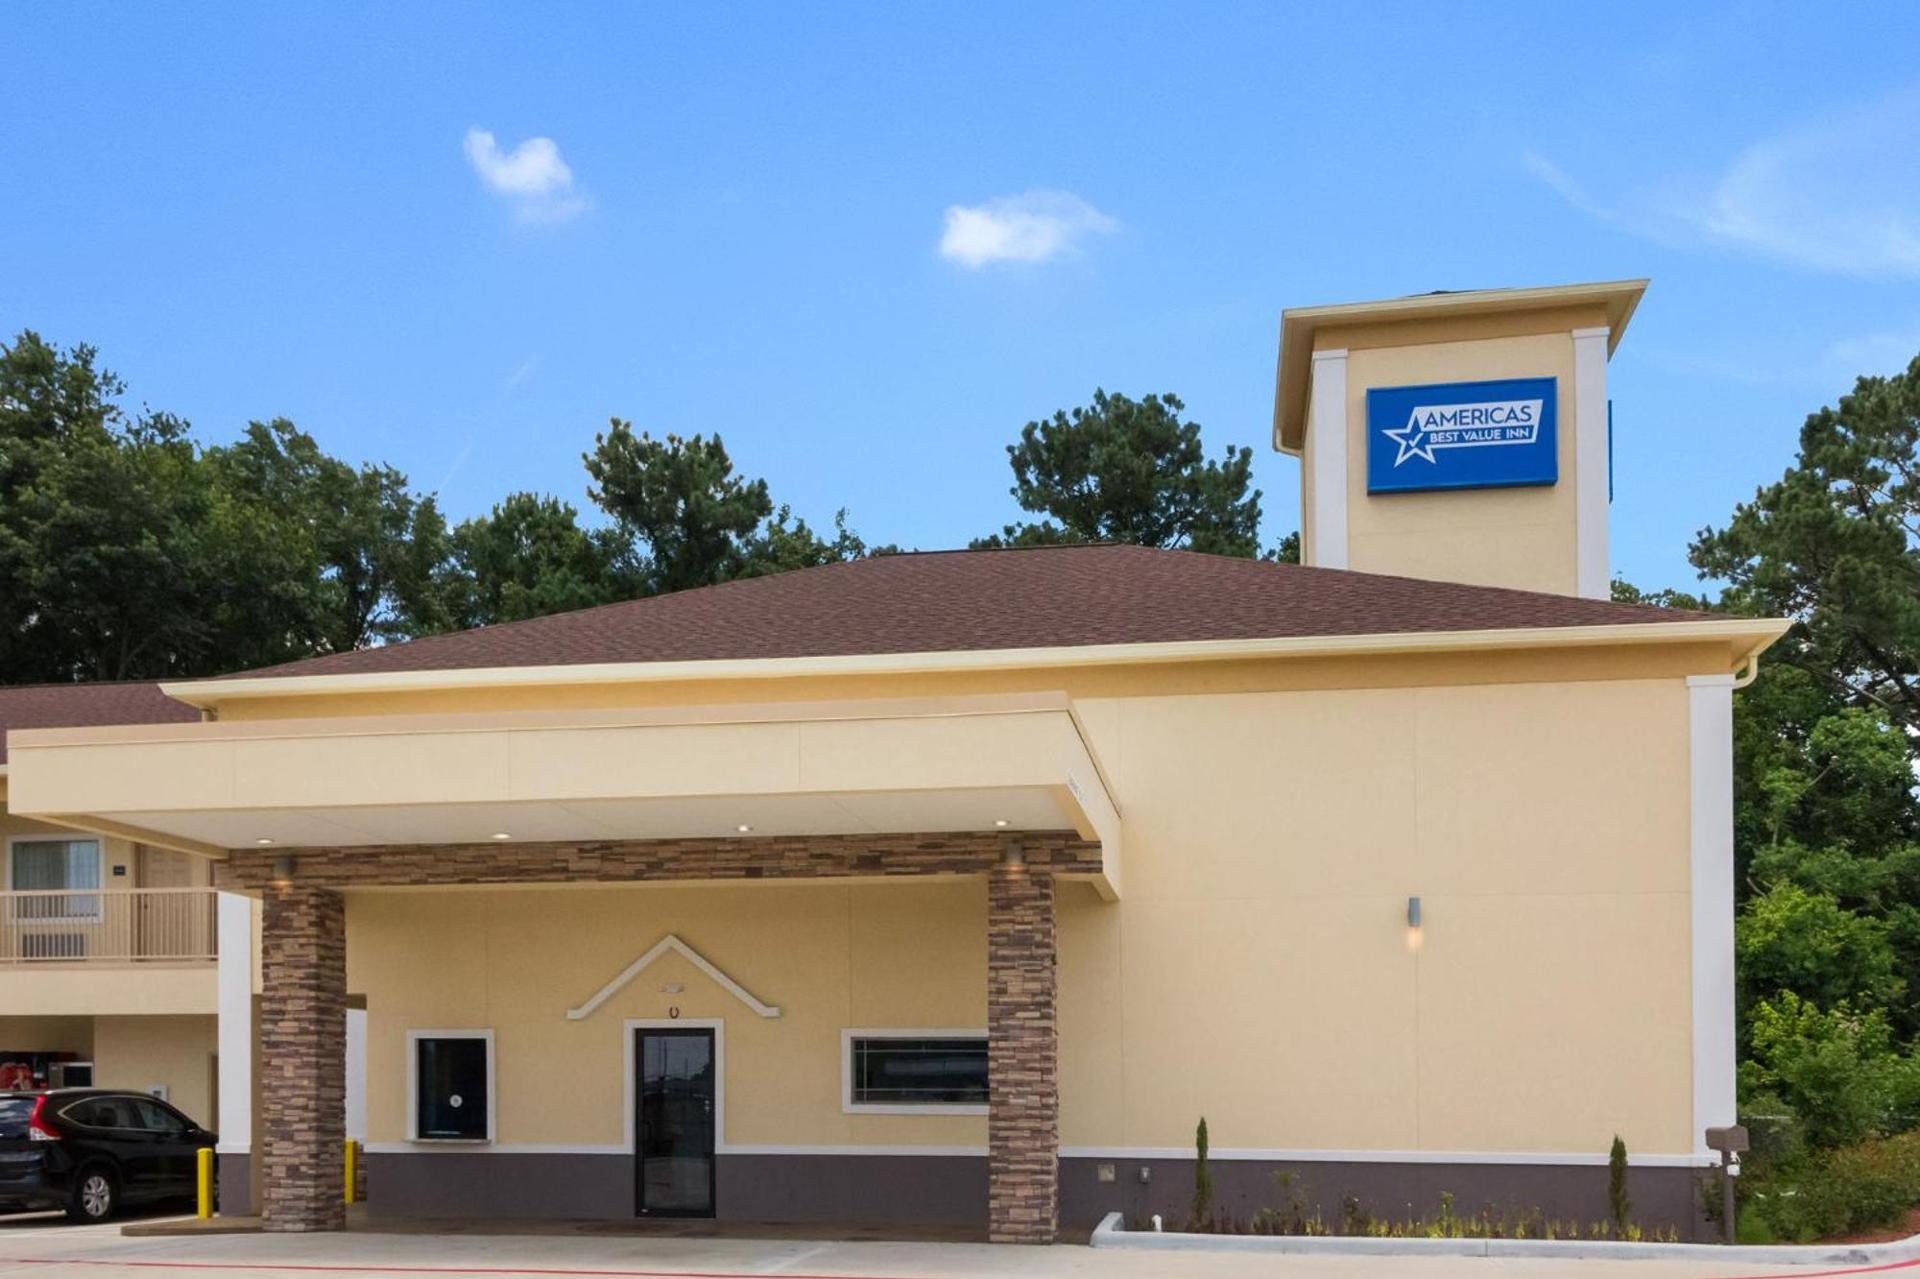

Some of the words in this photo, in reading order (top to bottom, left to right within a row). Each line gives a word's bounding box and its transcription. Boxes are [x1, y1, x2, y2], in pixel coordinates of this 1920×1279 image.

[1423, 405, 1532, 428] AMERICAS
[1430, 431, 1460, 443] BEST
[1462, 429, 1502, 441] VALUE
[1506, 427, 1530, 438] INN
